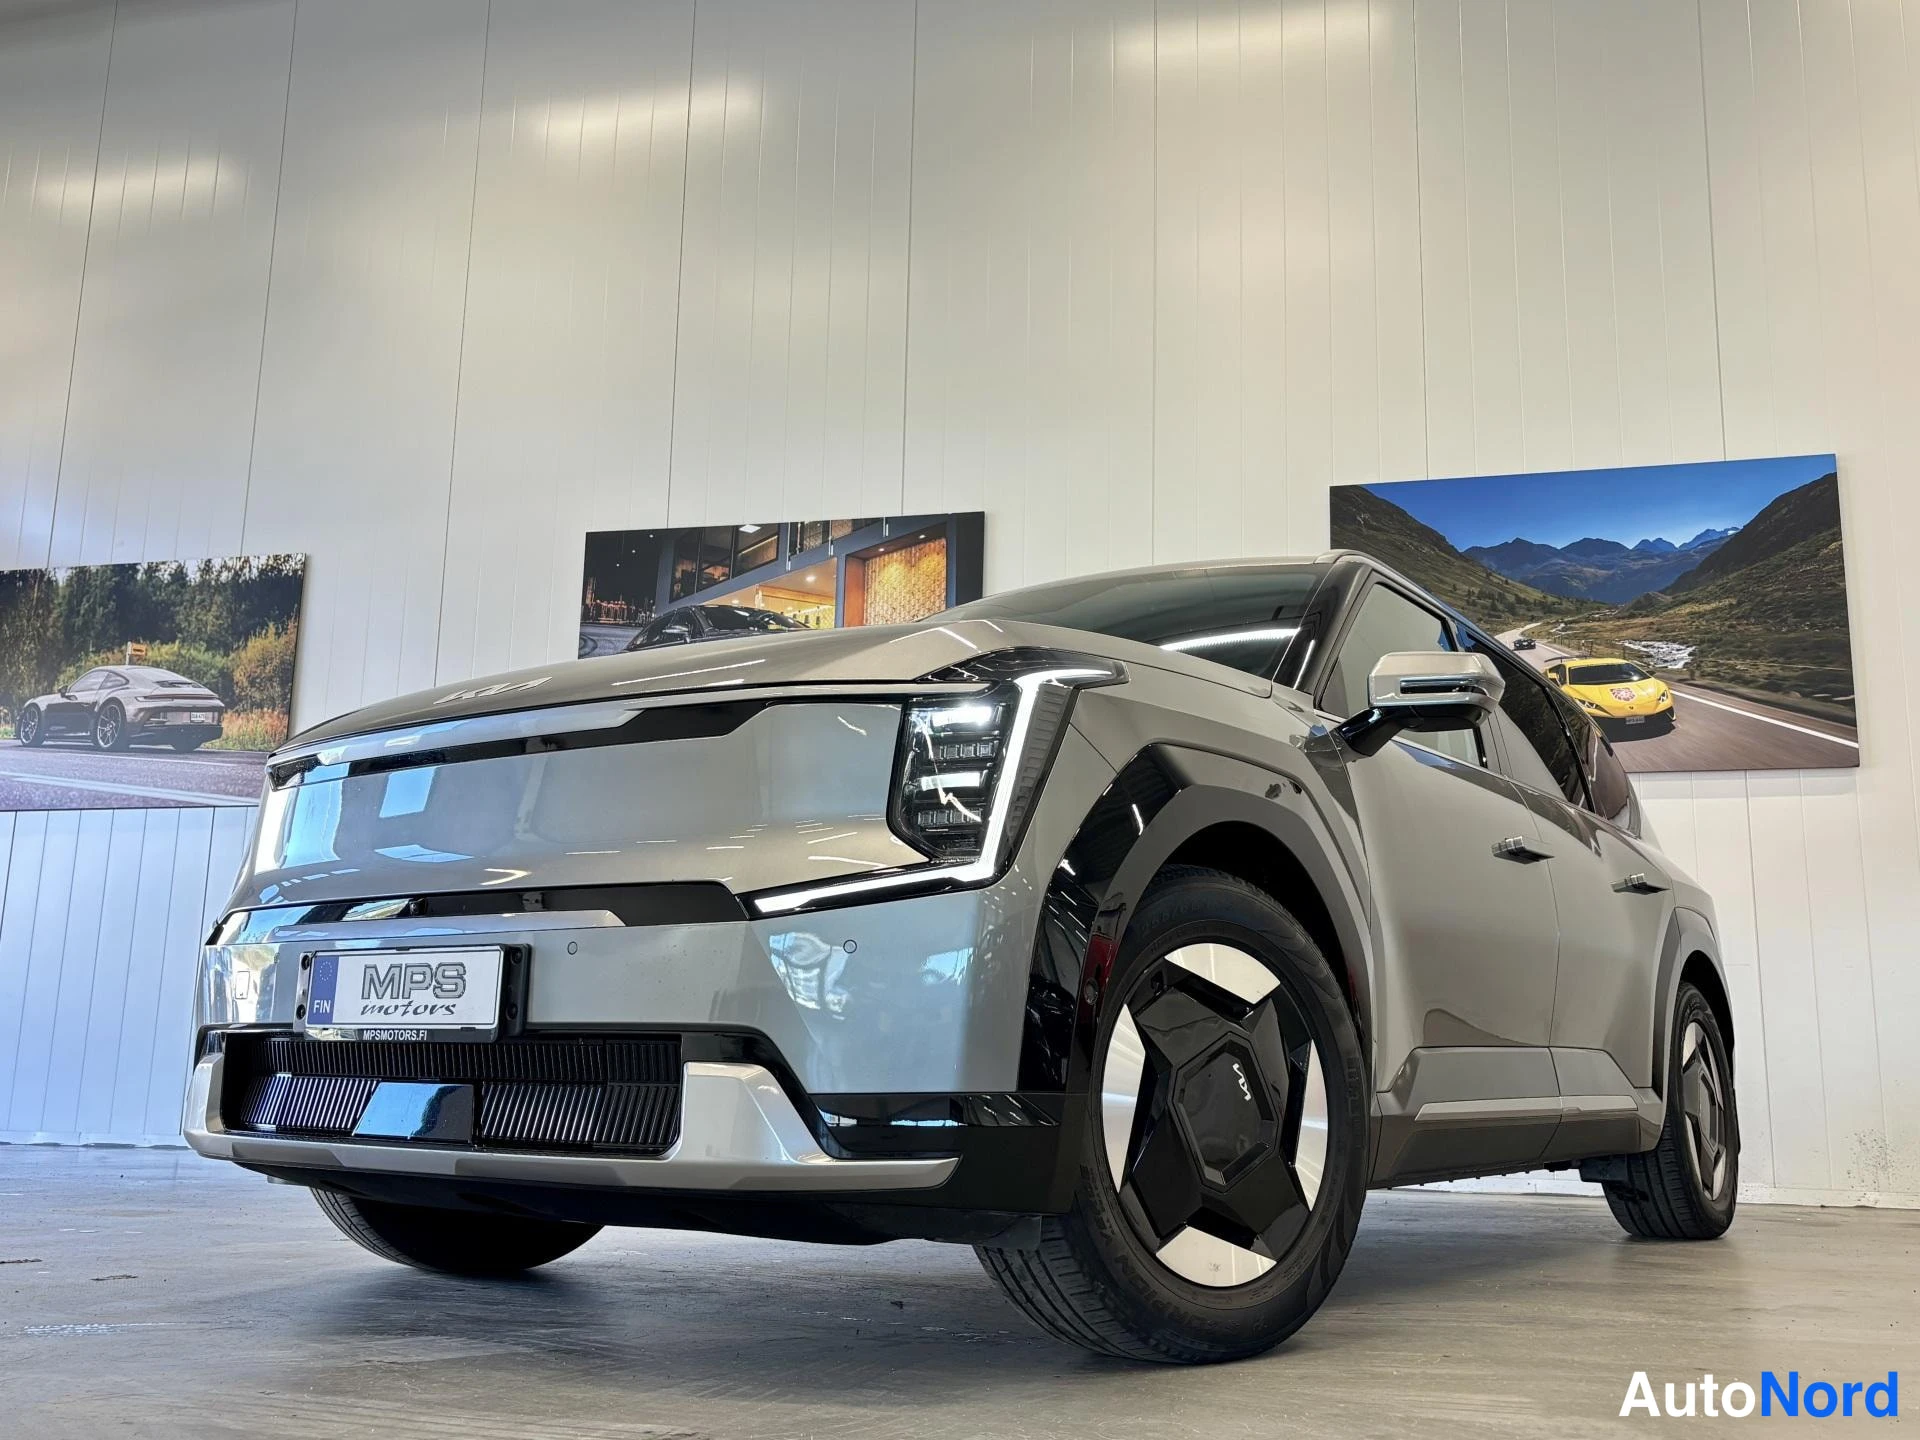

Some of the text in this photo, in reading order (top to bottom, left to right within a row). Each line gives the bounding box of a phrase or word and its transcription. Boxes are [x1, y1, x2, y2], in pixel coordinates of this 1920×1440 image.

[361, 962, 467, 1000] MPS
[313, 1000, 331, 1014] FIN
[361, 1000, 457, 1016] motors
[363, 1029, 428, 1041] MPSMOTORS.FI
